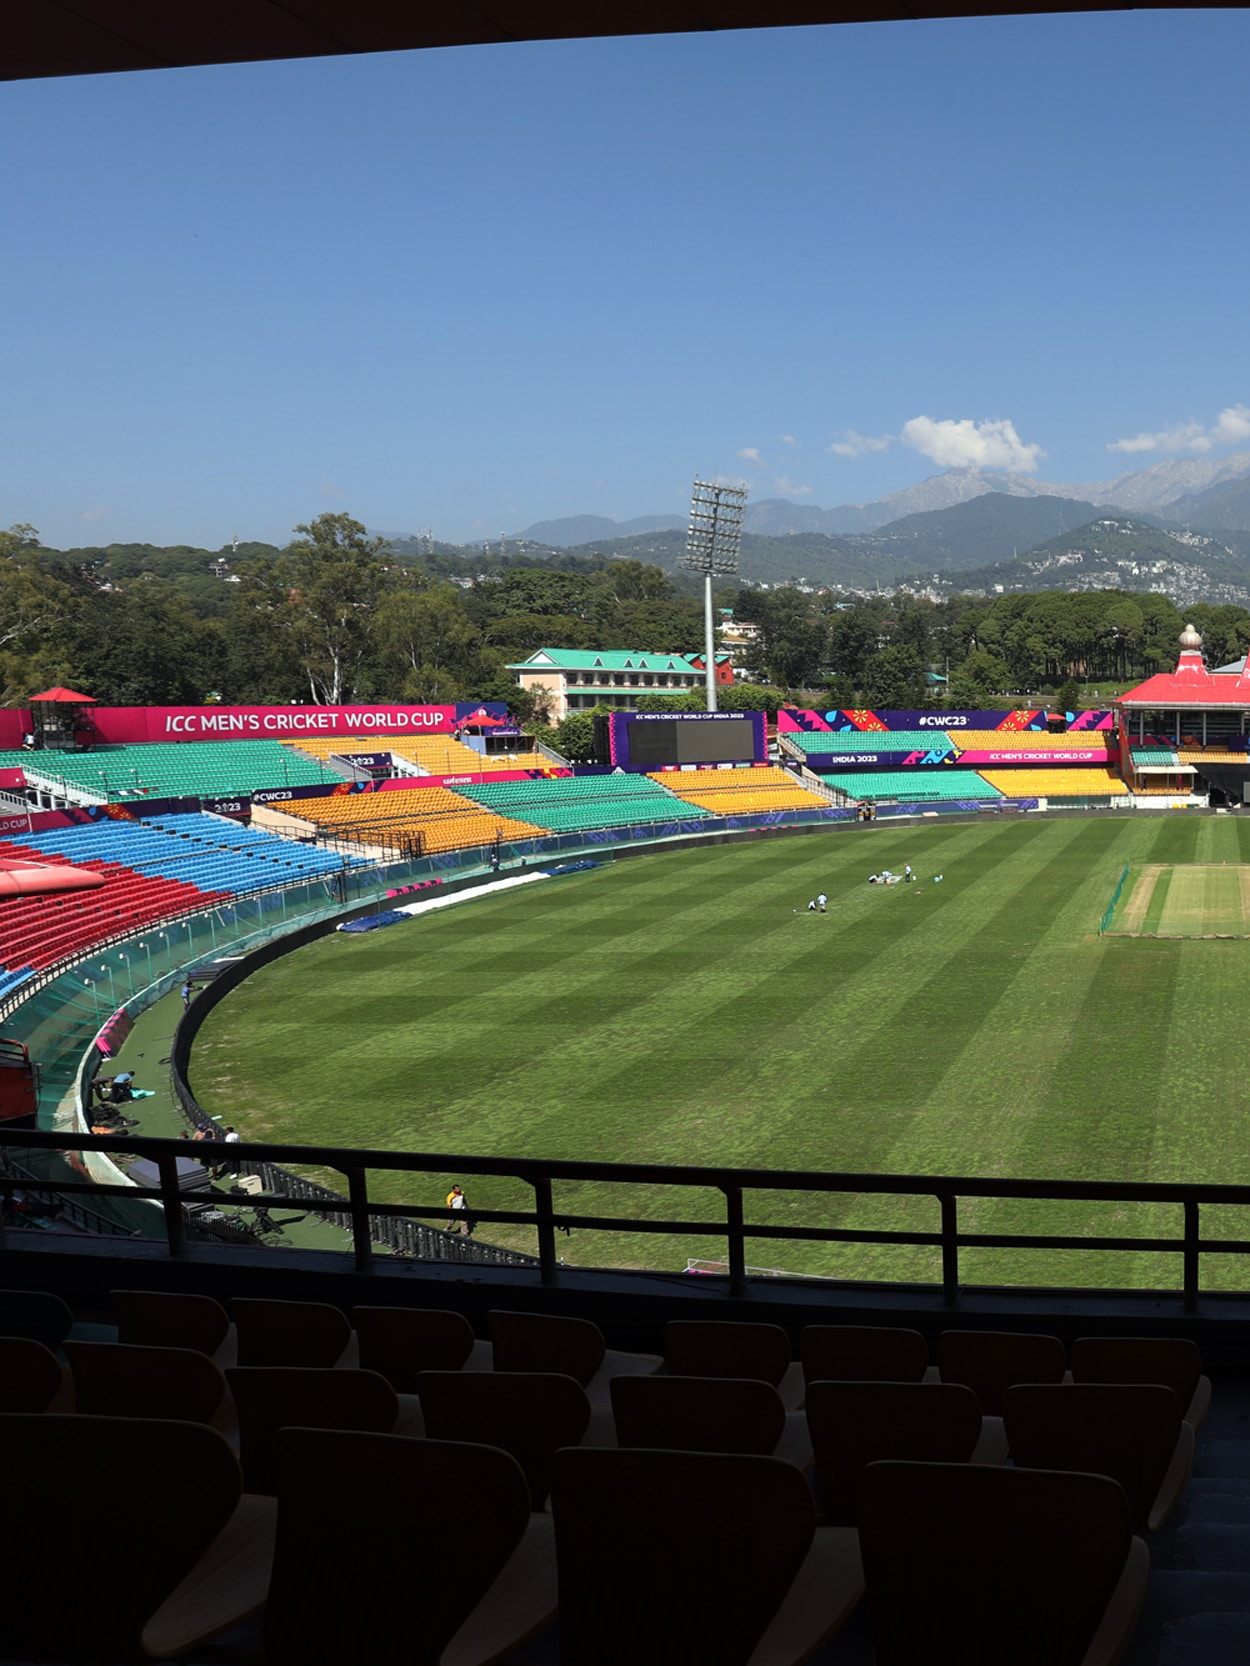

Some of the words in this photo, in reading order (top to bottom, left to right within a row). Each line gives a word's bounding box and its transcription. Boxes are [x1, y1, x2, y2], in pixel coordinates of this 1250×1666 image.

[165, 715, 196, 732] ICC
[201, 714, 260, 731] MEN'S
[263, 713, 339, 730] CRICKET
[346, 712, 408, 728] WORLD
[411, 712, 444, 727] CUP
[919, 716, 967, 726] #CWC23
[253, 791, 292, 802] #CWC23
[10, 818, 28, 829] CUP
